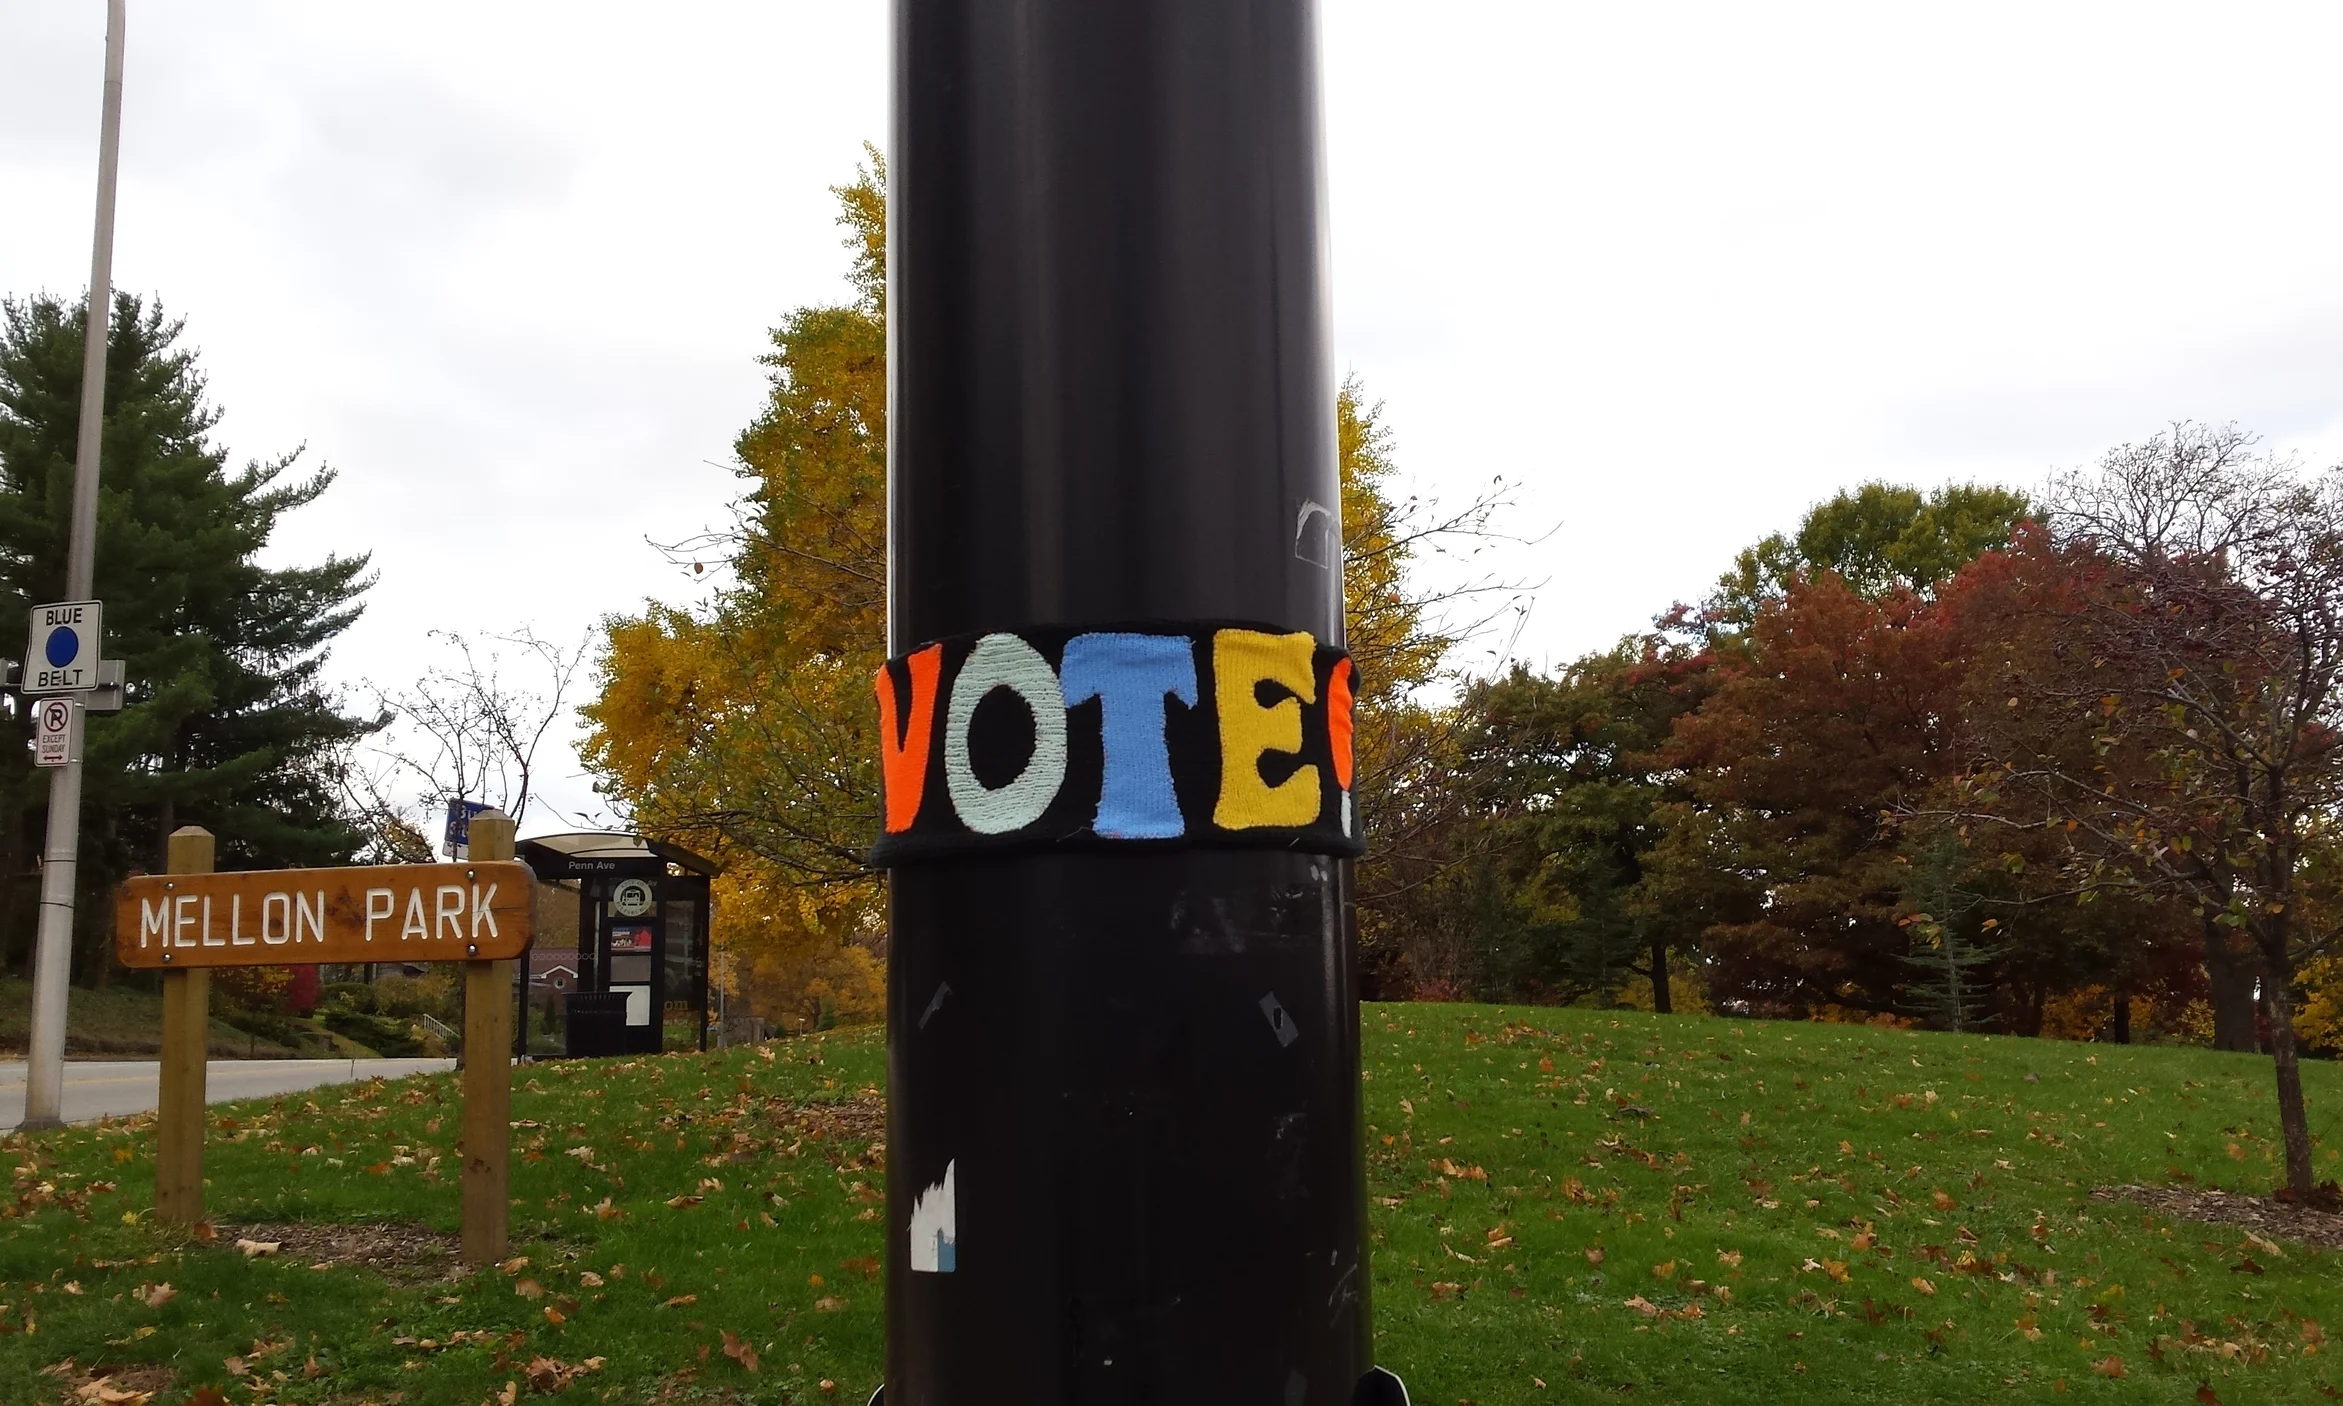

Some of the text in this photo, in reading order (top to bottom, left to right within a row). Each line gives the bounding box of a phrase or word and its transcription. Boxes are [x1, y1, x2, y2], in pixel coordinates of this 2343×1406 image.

[46, 607, 83, 626] BLUE
[38, 669, 83, 688] BELT
[42, 734, 66, 744] EXCEPT
[41, 744, 66, 753] SUNDAY
[568, 861, 616, 870] Penn Ave
[140, 882, 499, 948] MELLON PARK
